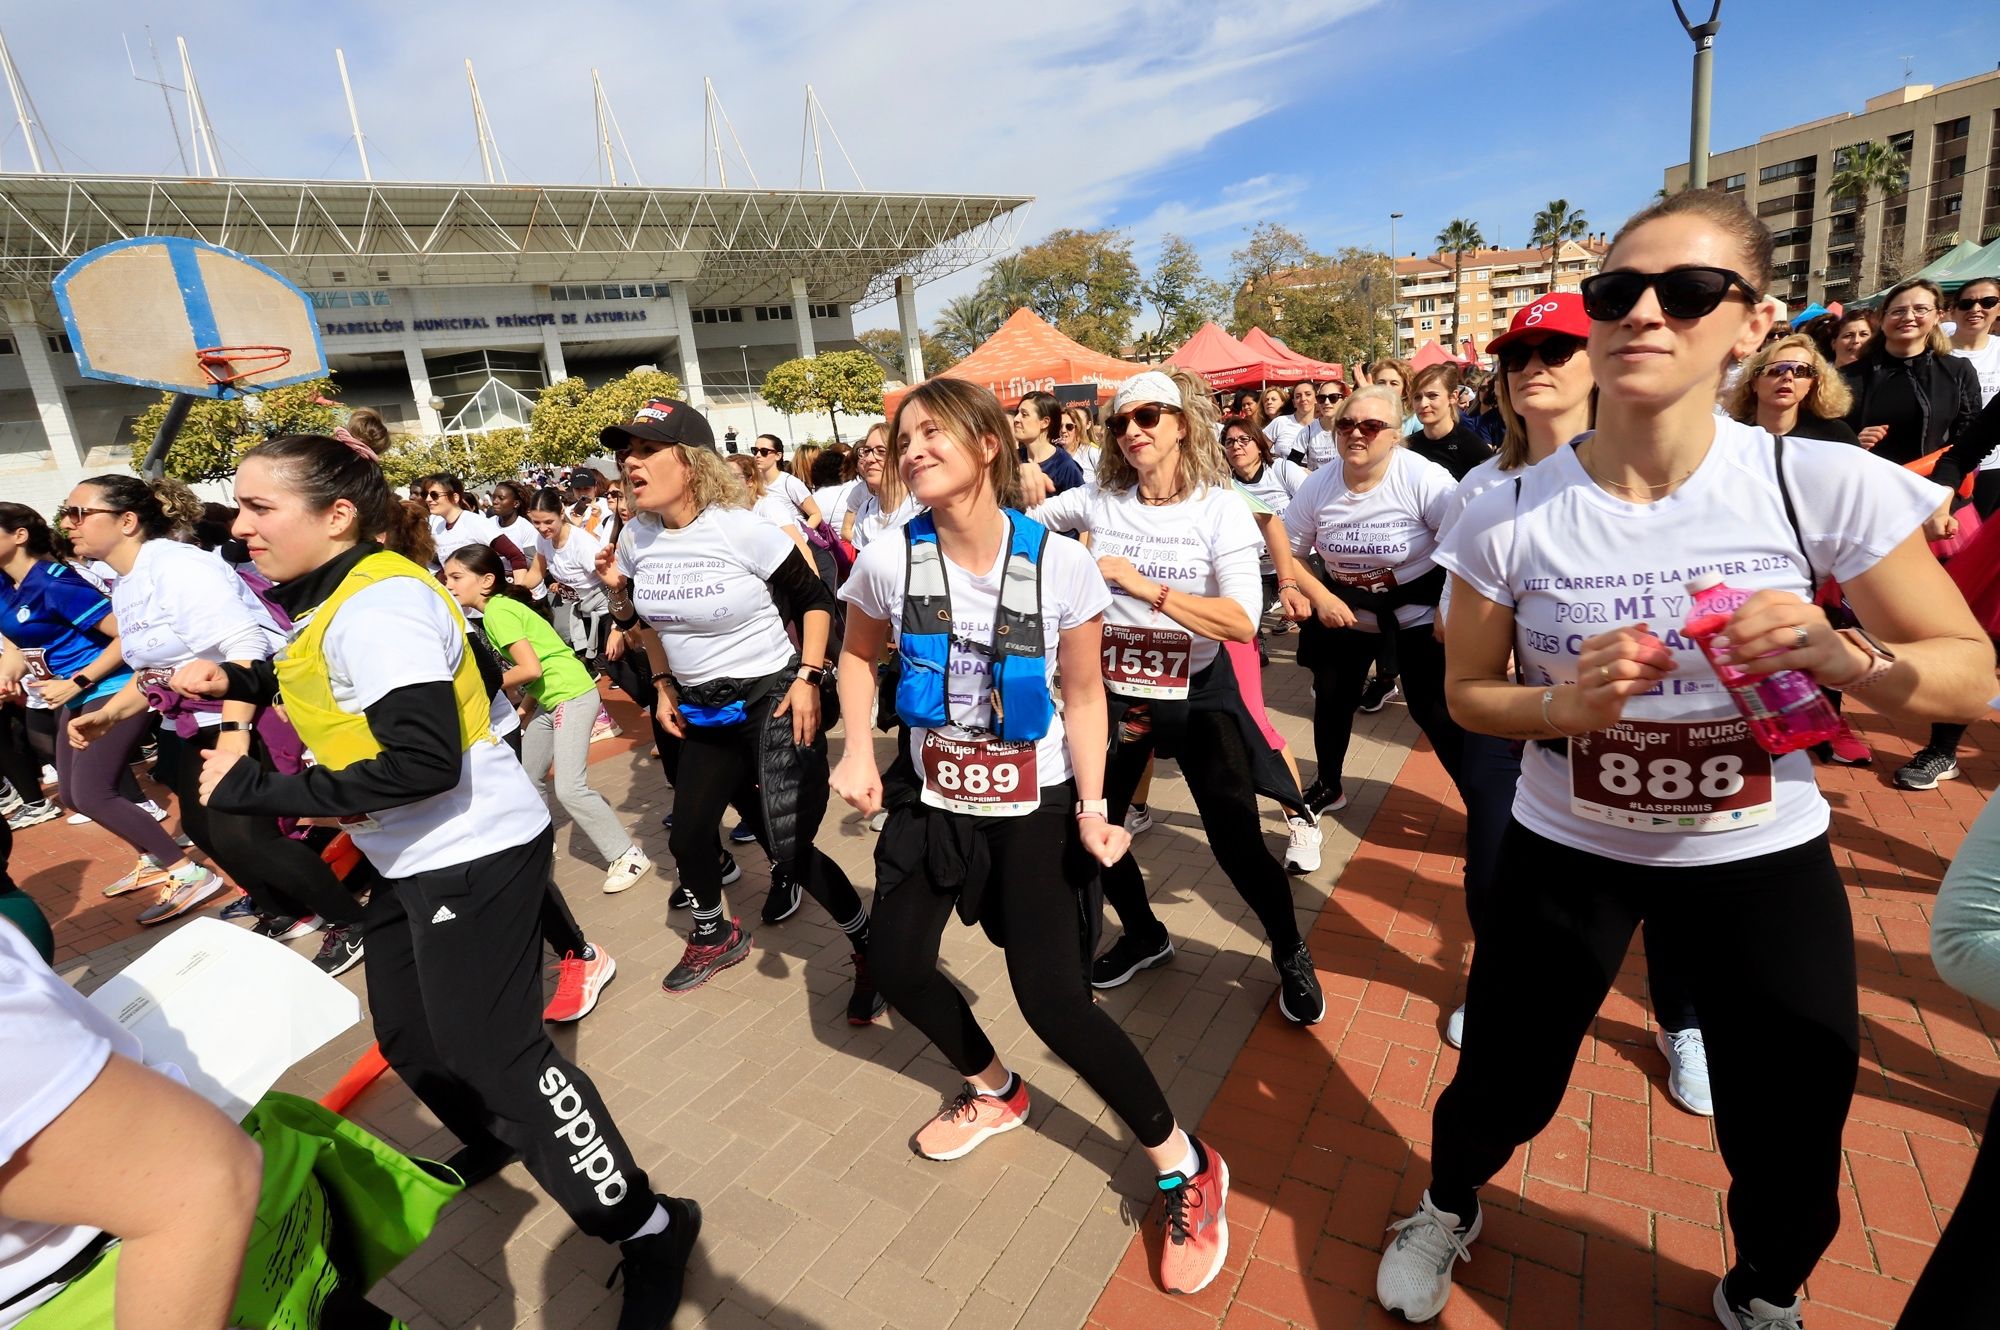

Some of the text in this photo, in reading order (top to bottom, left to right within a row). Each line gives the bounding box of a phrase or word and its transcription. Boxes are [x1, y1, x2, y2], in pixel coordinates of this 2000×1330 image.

[1525, 302, 1558, 326] go
[327, 310, 647, 335] PABELLÓN MUNICIPAL PRÍNCIPE DE ASTURIAS
[1007, 375, 1057, 399] fibra
[1104, 528, 1134, 541] CARRERA
[1156, 536, 1179, 545] MUJER
[1346, 529, 1359, 541] MÍ
[1361, 533, 1369, 541] Y
[1370, 532, 1391, 542] POR
[1098, 541, 1178, 562] POR MÍ Y POR
[1328, 542, 1407, 555] COMPAÑERAS
[674, 561, 682, 569] LA
[683, 560, 704, 569] MUJER
[706, 560, 726, 569] 2023
[656, 570, 671, 585] MÍ
[673, 574, 681, 585] Y
[681, 572, 703, 585] POR
[1524, 578, 1550, 591] VIII
[1555, 574, 1627, 590] CARRERA
[1633, 572, 1654, 586] DE
[1661, 570, 1681, 584] LA
[1752, 555, 1789, 572] 2023
[637, 583, 725, 600] COMPAÑERAS
[1556, 602, 1607, 624] POR
[1615, 588, 1655, 621] MÍ
[1663, 595, 1684, 617] Y
[961, 621, 974, 631] DE
[977, 622, 990, 631] LA
[1117, 631, 1145, 646] mujer
[1153, 632, 1188, 640] MURCIA
[1527, 628, 1560, 654] MIS
[1005, 642, 1037, 653] EVADICT
[1103, 645, 1187, 678] 1537
[1126, 677, 1157, 686] MANUELA
[1689, 721, 1751, 740] MURC
[986, 740, 1031, 752] MURCIA
[1605, 728, 1671, 752] mujer
[1711, 733, 1745, 745] MARZO
[940, 745, 977, 760] mujer
[937, 760, 1019, 794] 889
[1599, 752, 1745, 800] 888
[955, 794, 1001, 803] #LASPRIMIS
[1629, 801, 1713, 813] #LASPRIMIS
[432, 912, 457, 924] adidas
[699, 927, 717, 936] adidas
[538, 1066, 628, 1206] adidas
